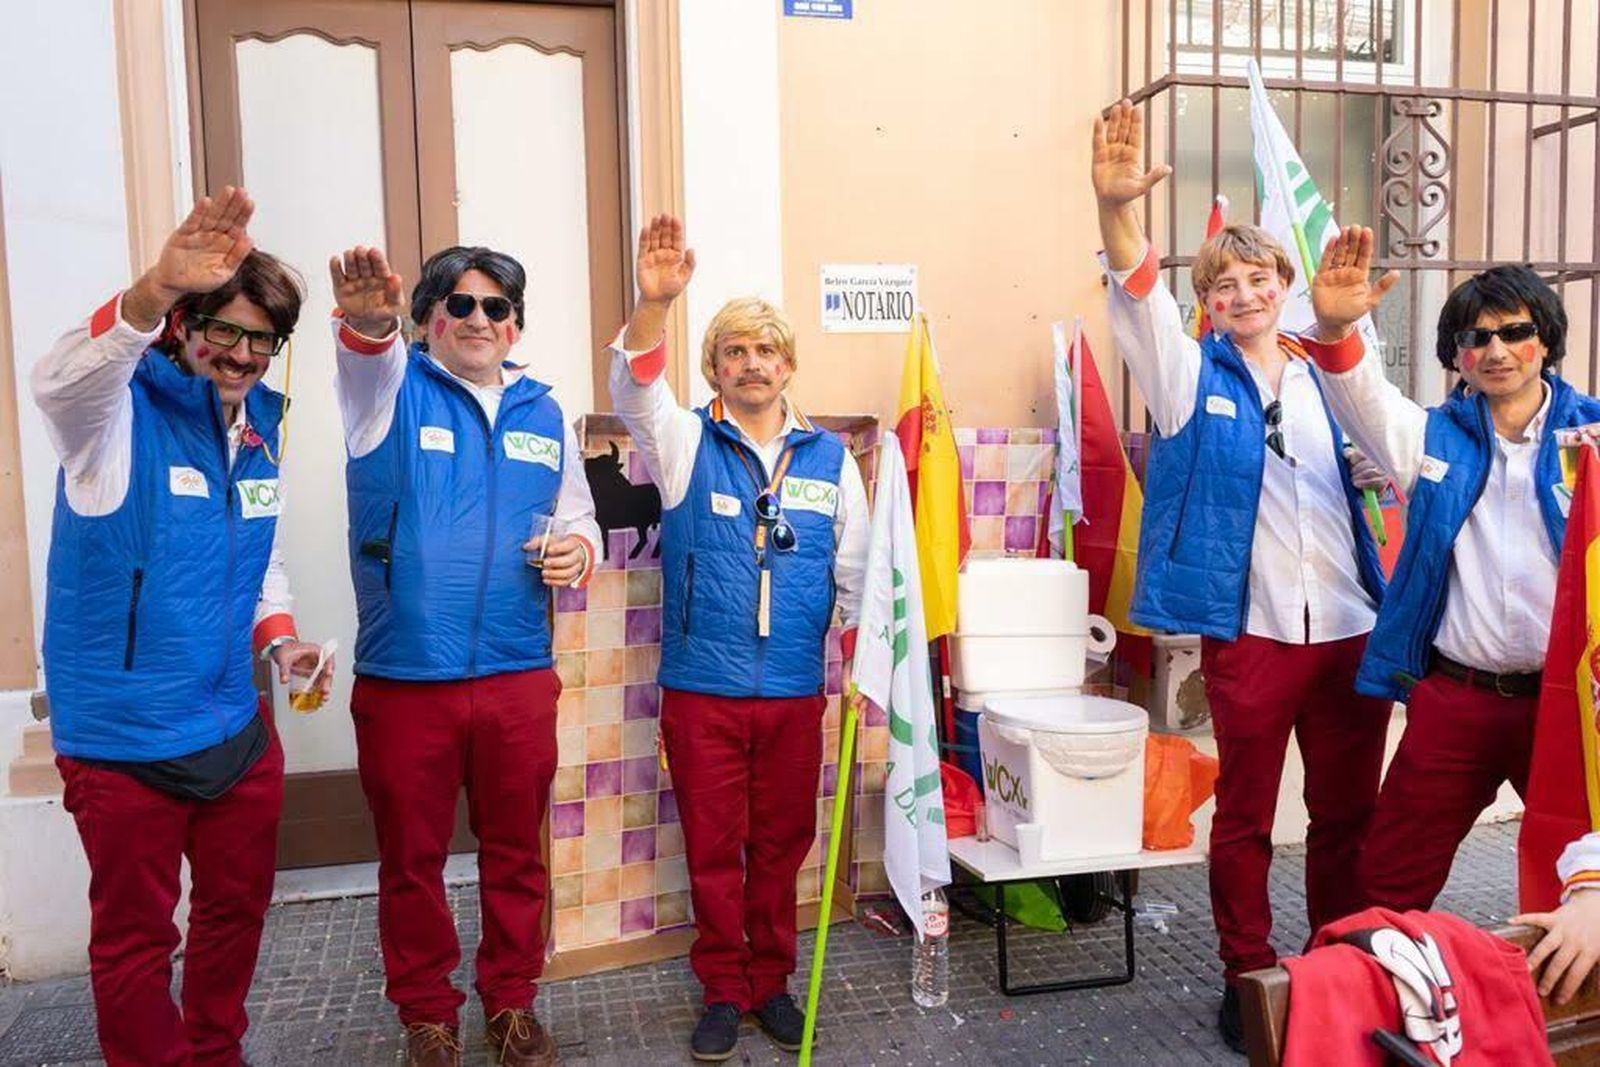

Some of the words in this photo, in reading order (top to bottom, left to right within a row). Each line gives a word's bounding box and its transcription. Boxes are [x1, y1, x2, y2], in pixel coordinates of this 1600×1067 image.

[842, 291, 913, 321] NOTARIO
[1177, 304, 1197, 325] TA
[1380, 345, 1411, 368] UE
